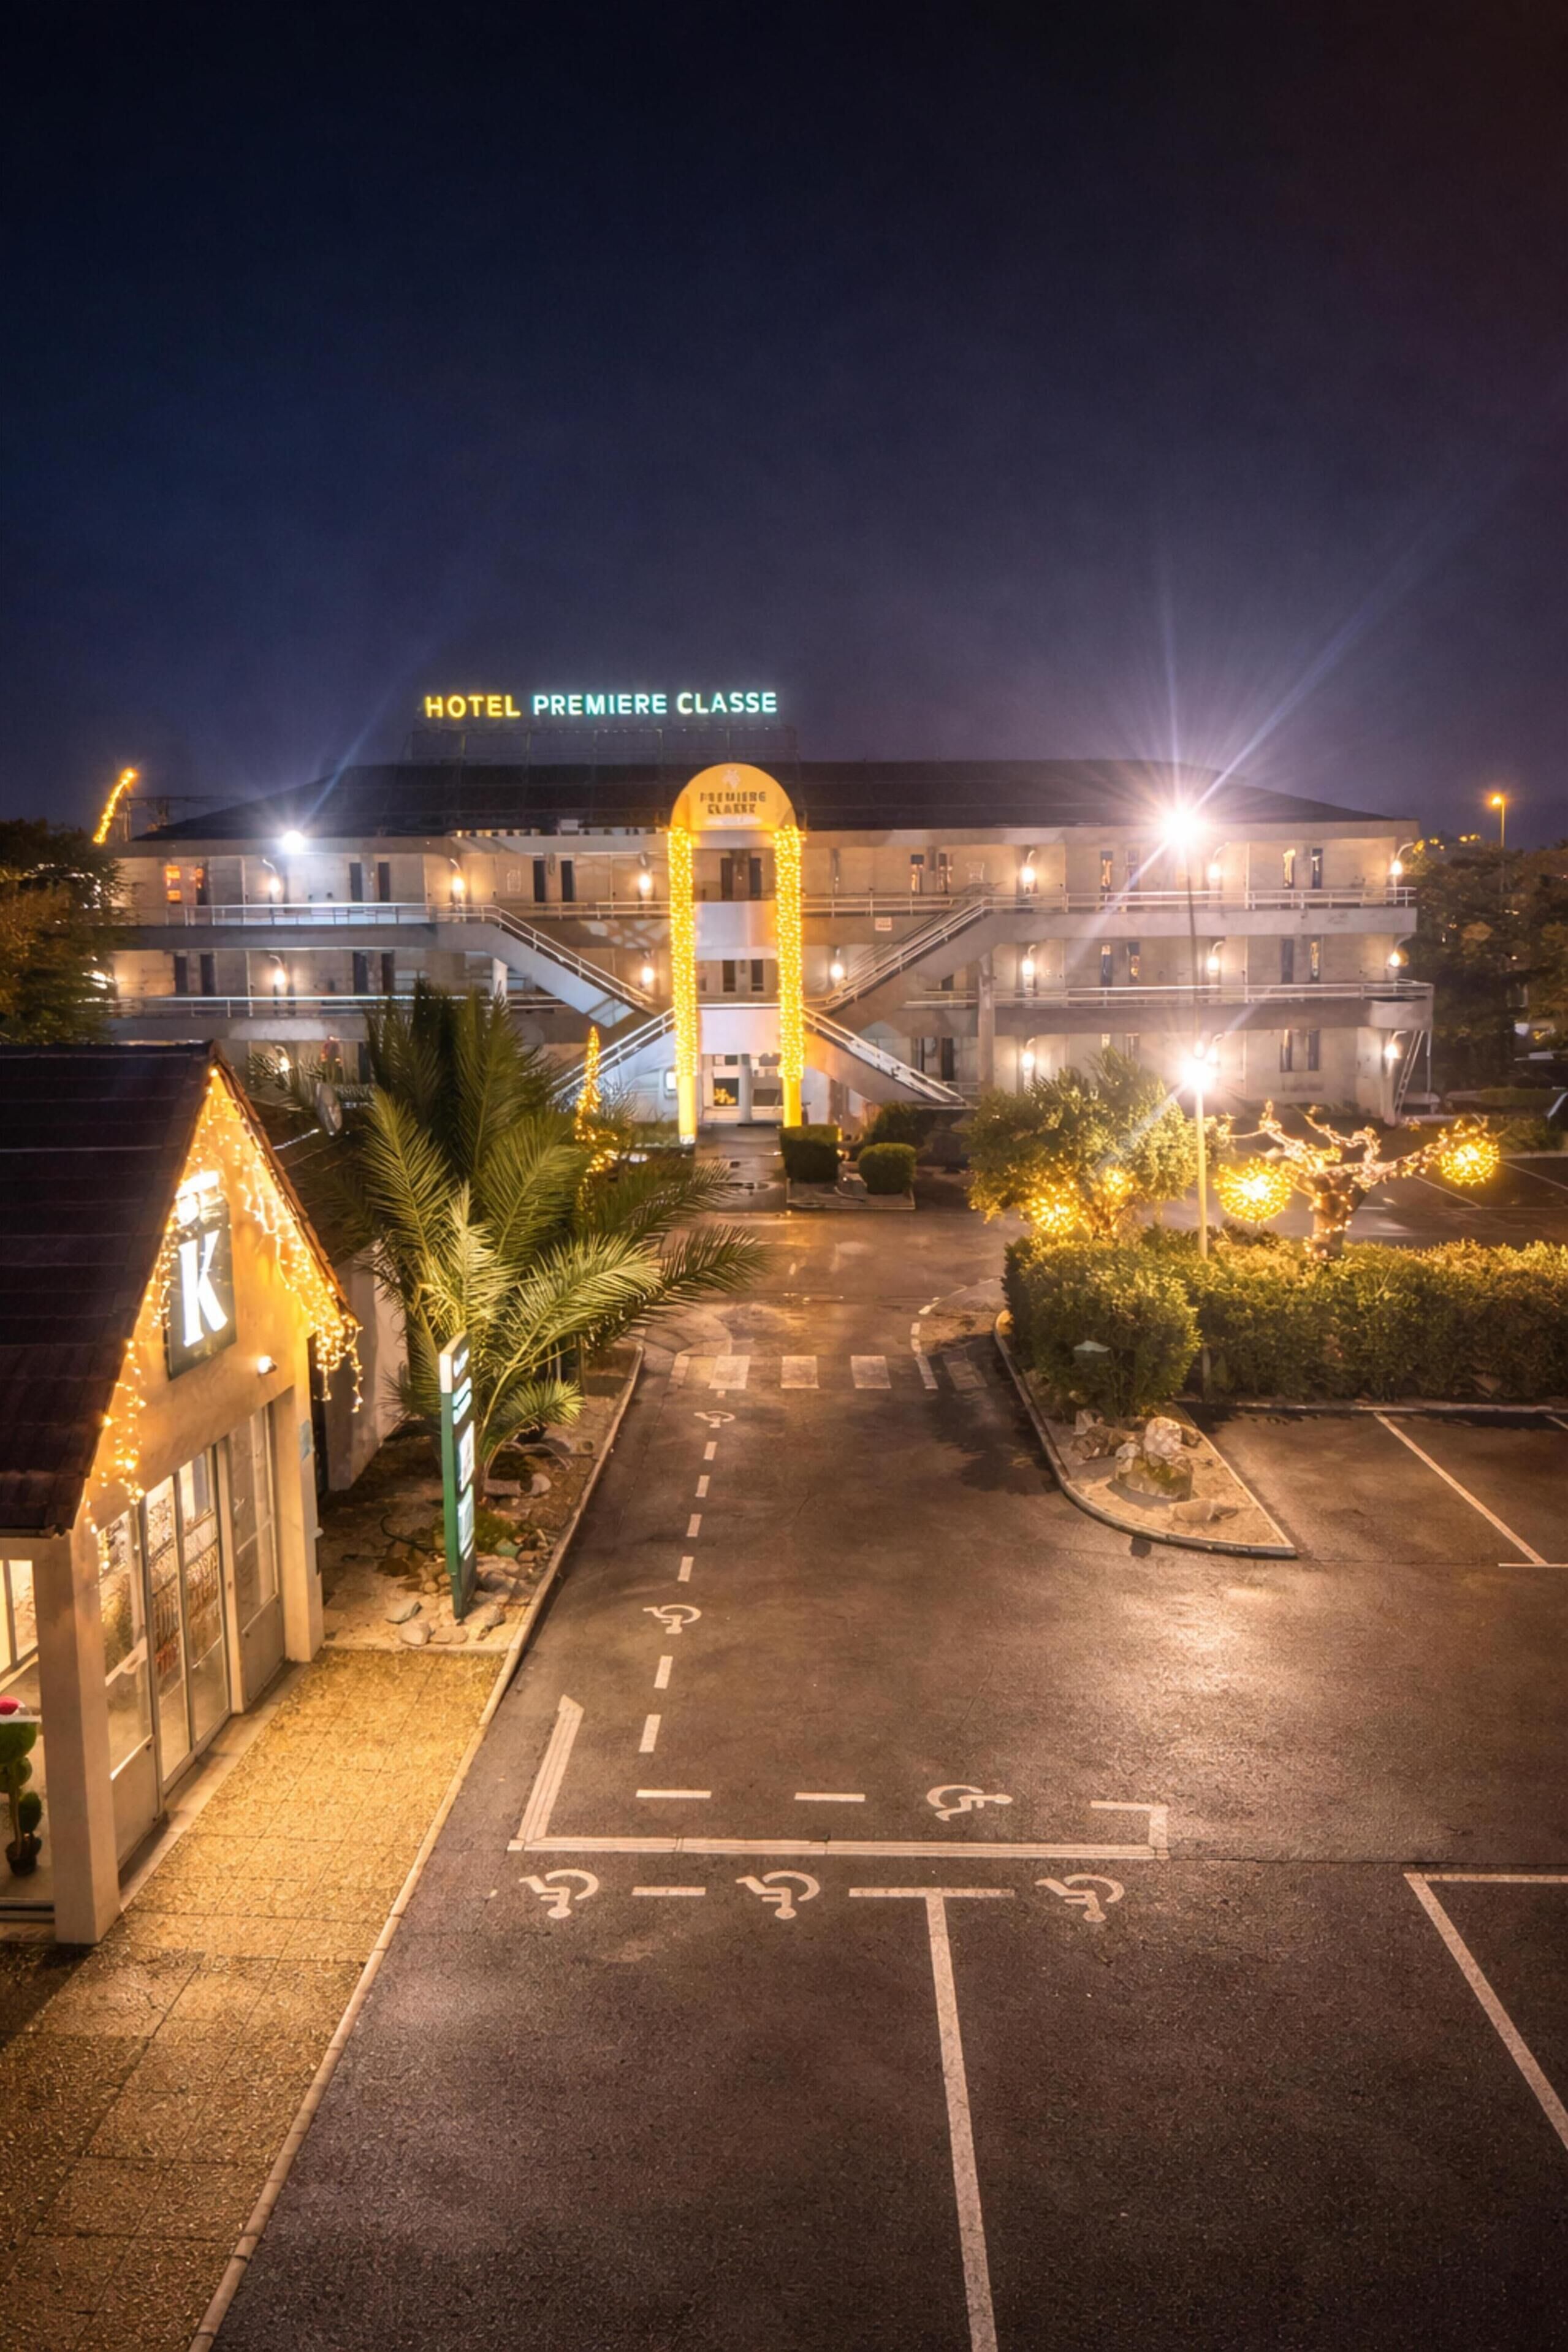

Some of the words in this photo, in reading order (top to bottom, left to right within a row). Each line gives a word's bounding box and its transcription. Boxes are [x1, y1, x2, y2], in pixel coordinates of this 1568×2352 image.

[425, 695, 521, 718] HOTEL
[533, 693, 668, 716] PREMIERE
[677, 691, 777, 715] CLASSE
[178, 1229, 228, 1347] K
